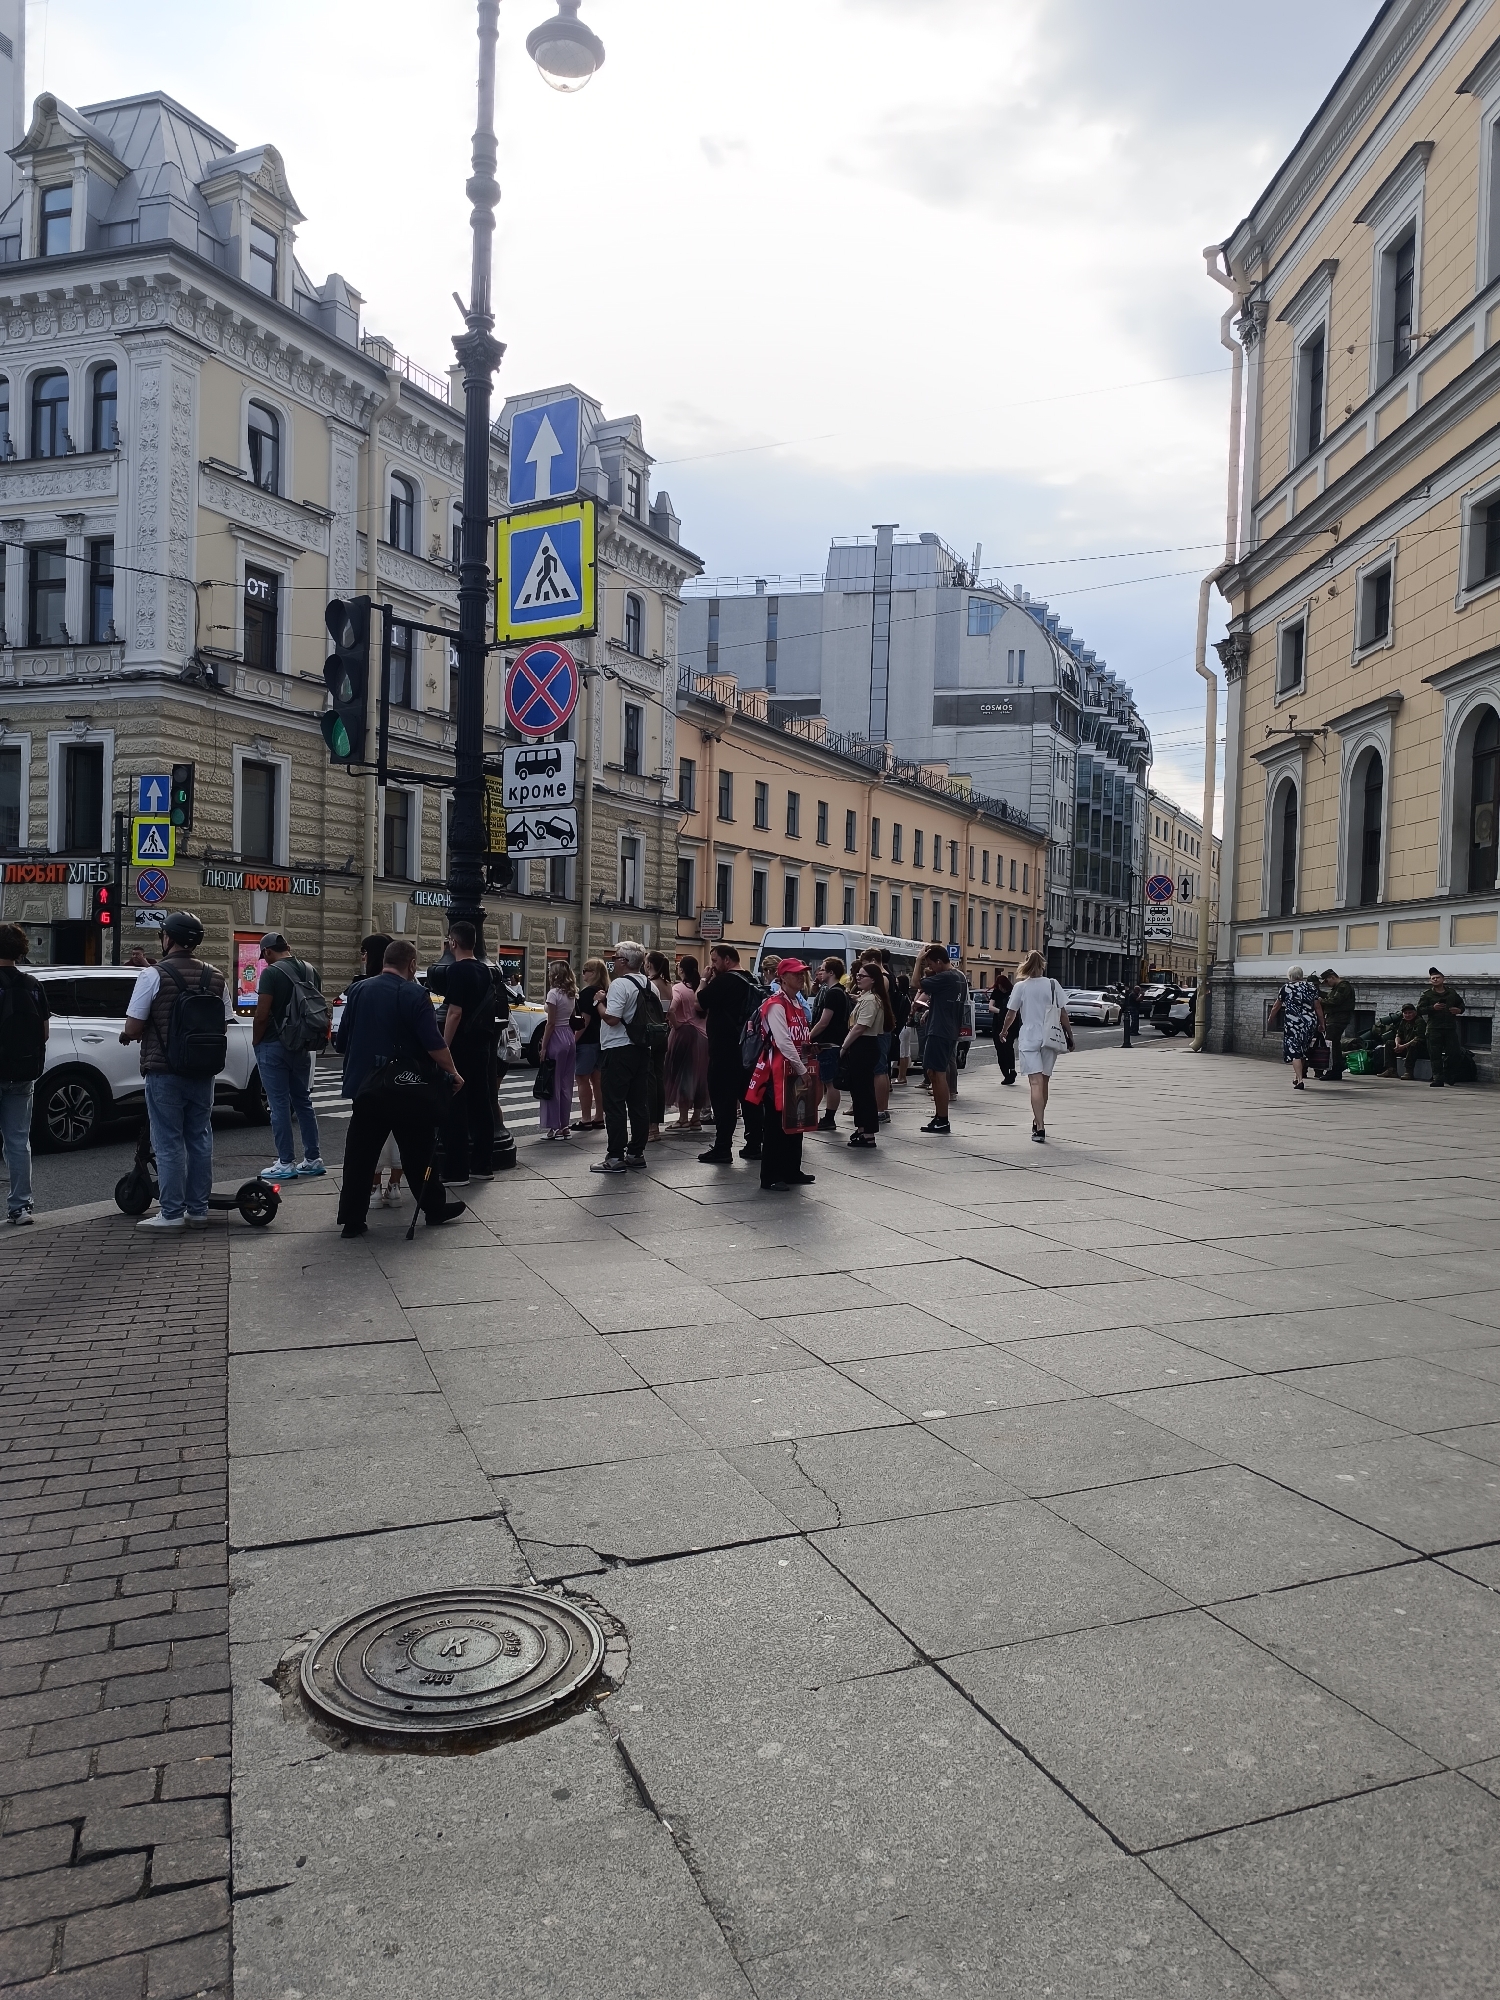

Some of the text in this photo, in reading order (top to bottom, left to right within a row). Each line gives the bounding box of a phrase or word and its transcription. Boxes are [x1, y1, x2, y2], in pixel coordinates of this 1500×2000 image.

[247, 578, 269, 599] ОТ
[508, 782, 567, 805] кроме
[5, 864, 67, 883] ЛЮБЯТ
[68, 863, 108, 883] ХЛЕБ
[205, 870, 321, 896] ЛЮДИ ЛЮБЯТ ХЛЕБ
[1147, 916, 1171, 924] кроме
